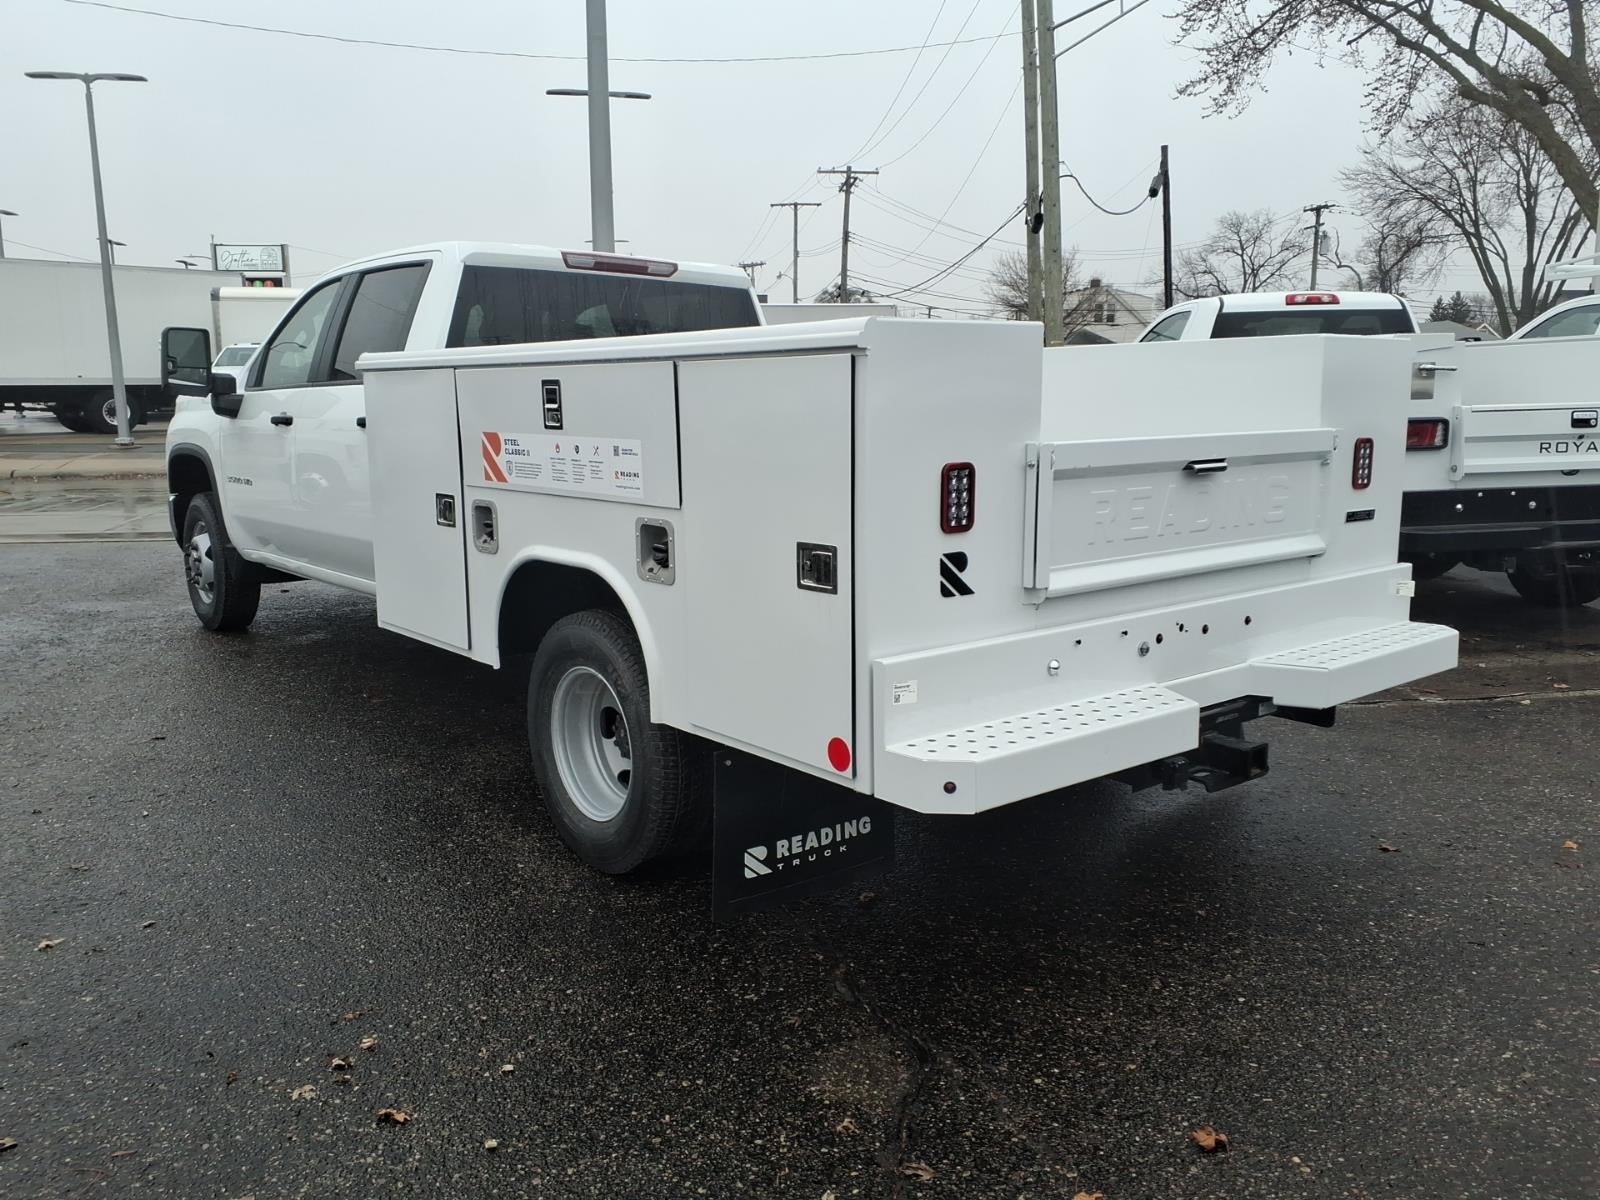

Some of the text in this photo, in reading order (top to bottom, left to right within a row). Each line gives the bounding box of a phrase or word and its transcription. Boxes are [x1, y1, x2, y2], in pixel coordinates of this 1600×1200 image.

[504, 439, 520, 447] STEEL
[504, 448, 525, 457] CLASSIC
[1539, 441, 1599, 454] ROYA
[1087, 475, 1289, 546] READING
[776, 816, 872, 859] READING
[777, 844, 847, 870] TRUCK
